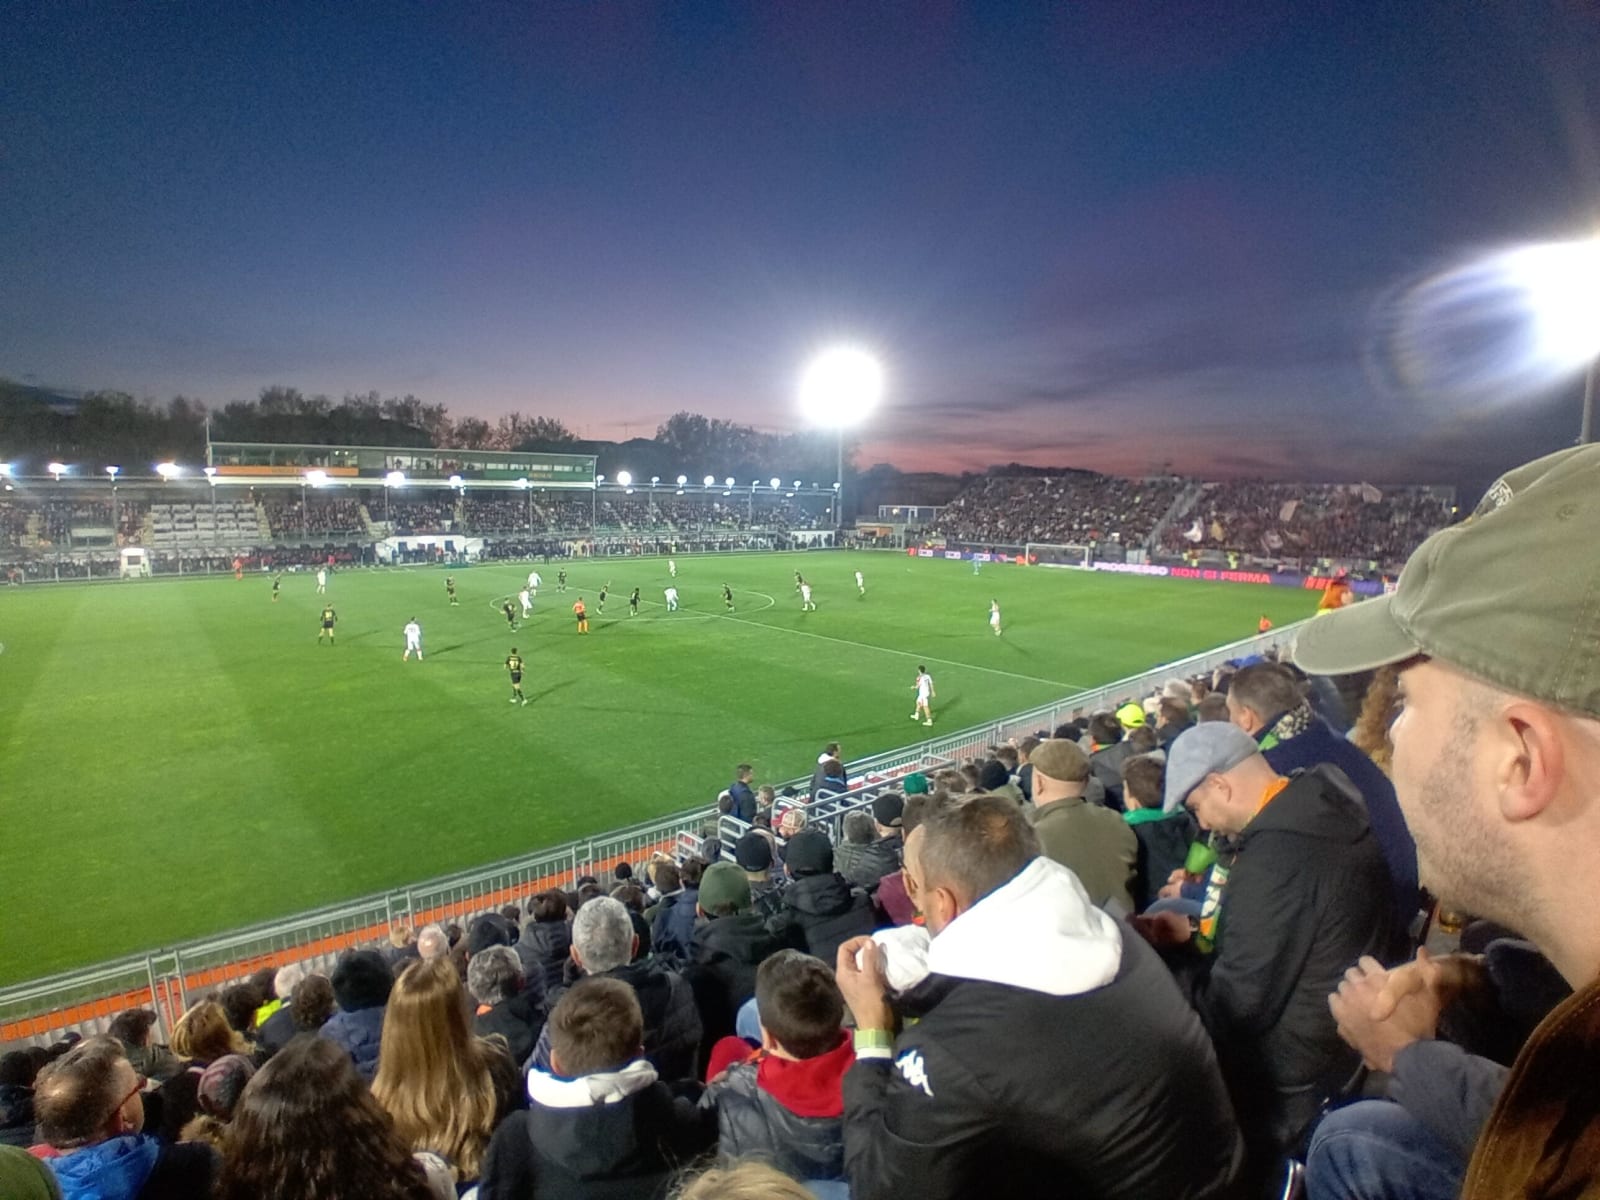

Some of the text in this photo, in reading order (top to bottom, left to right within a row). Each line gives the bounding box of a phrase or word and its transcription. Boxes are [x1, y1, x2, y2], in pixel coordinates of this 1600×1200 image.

[1093, 562, 1271, 584] PROGRESSO NON SI FERMA
